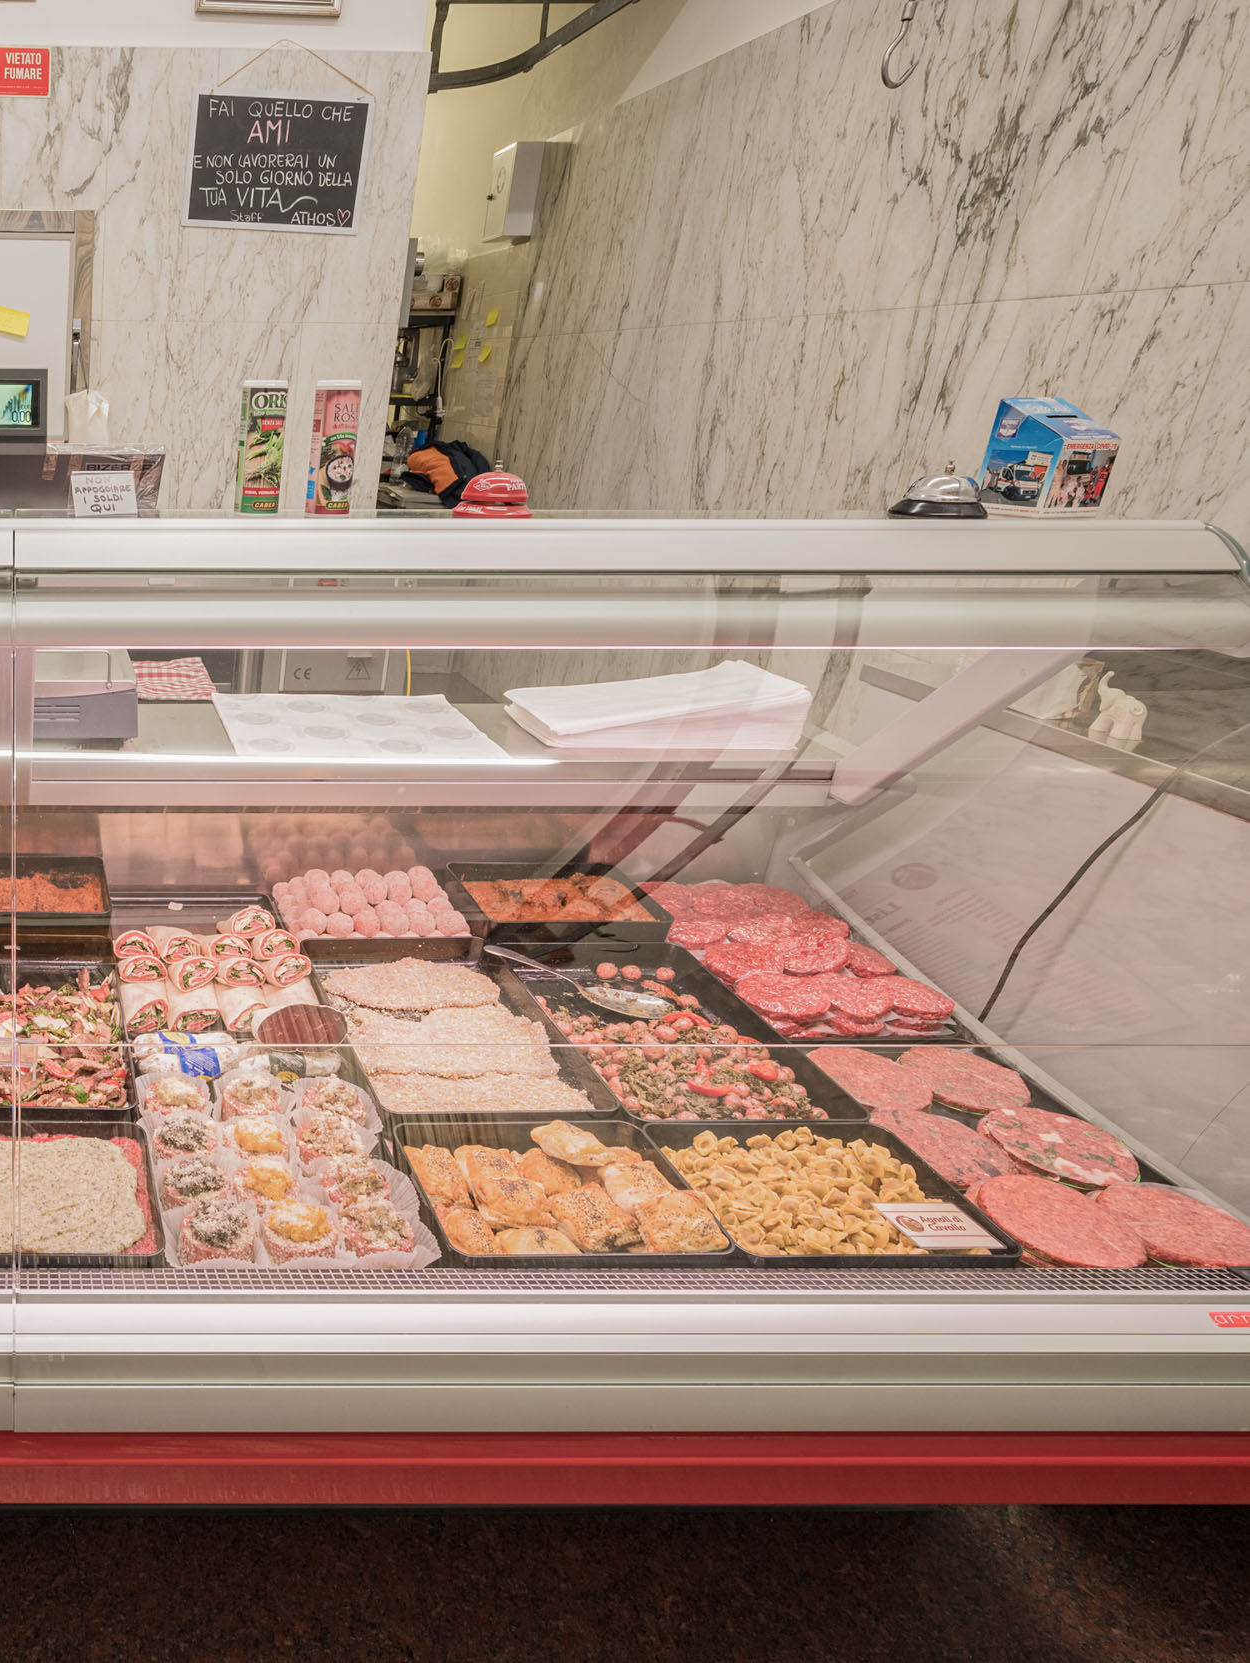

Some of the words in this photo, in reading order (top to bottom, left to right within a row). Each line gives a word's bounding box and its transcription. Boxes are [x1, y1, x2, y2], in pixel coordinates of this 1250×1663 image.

[5, 52, 42, 65] VIETATO
[4, 67, 42, 80] FUMARE
[209, 98, 234, 118] FAI
[248, 101, 313, 118] QUELLO
[321, 106, 355, 122] CHE
[246, 119, 291, 146] AMI
[193, 154, 203, 169] E
[206, 153, 235, 168] NON
[238, 153, 309, 169] LAVORERAI
[318, 153, 338, 168] UN
[215, 170, 252, 185] SOLO
[259, 170, 313, 186] GIORNO
[318, 171, 353, 187] DELLA
[199, 187, 228, 207] TUA
[236, 187, 295, 211] VITA
[230, 209, 265, 223] Staff
[290, 211, 336, 227] ATHOS
[333, 412, 359, 423] ROS
[85, 475, 111, 485] NON
[93, 493, 124, 503] SOLDI
[90, 503, 116, 513] QUI
[293, 667, 311, 680] CE
[952, 1215, 964, 1223] di
[927, 1223, 967, 1231] Cavallo
